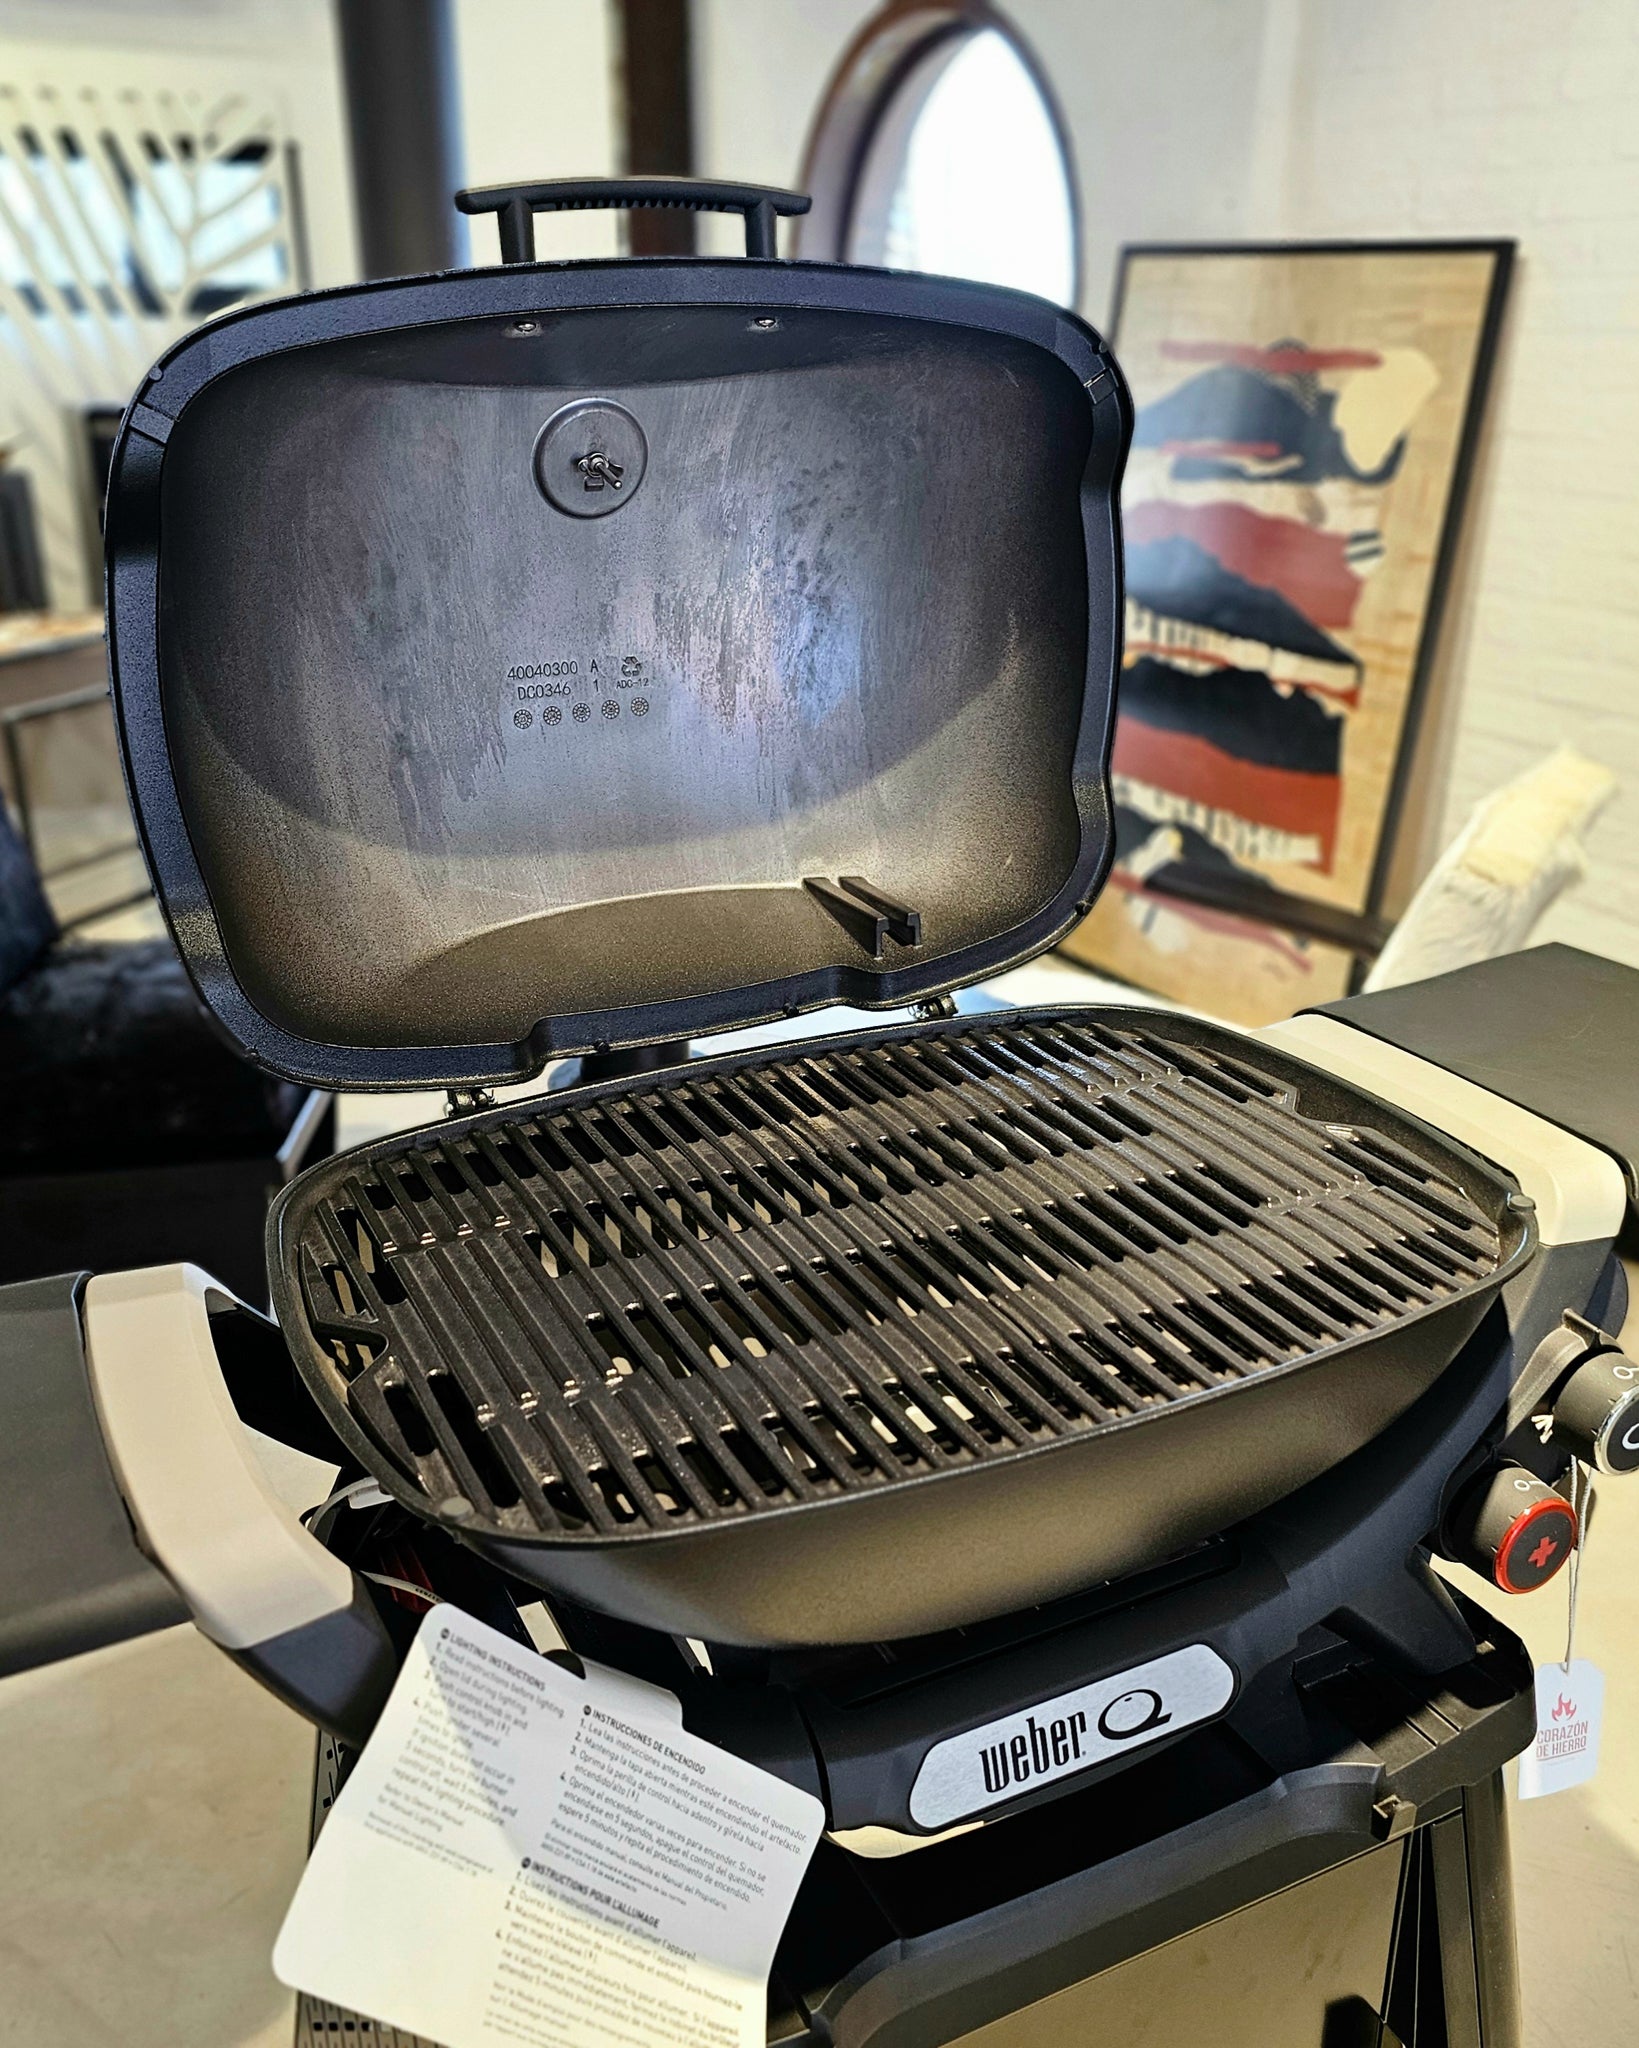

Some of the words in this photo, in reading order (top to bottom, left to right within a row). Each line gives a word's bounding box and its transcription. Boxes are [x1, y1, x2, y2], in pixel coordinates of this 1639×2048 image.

[507, 660, 579, 680] 40040300
[590, 659, 599, 673] A
[517, 682, 572, 700] DC0346
[593, 679, 599, 692] 1
[438, 1660, 459, 1678] Open
[471, 1678, 497, 1699] during
[444, 1647, 465, 1664] Read
[465, 1658, 510, 1688] instructions
[509, 1682, 534, 1701] before
[449, 1633, 488, 1660] LIGHTING
[487, 1654, 546, 1692] INSTRUCTIONS
[454, 1687, 484, 1706] control
[482, 1700, 503, 1716] knob
[502, 1711, 512, 1721] in
[512, 1718, 528, 1729] and
[471, 1728, 501, 1747] several
[591, 1708, 653, 1747] INSTRUCCIONES
[652, 1740, 663, 1753] DE
[663, 1746, 706, 1775] ENCENDIDO
[979, 1711, 1087, 1793] weber
[1098, 1689, 1172, 1740] Q
[1536, 1744, 1549, 1758] DE
[1552, 1736, 1587, 1755] HIERRO
[1537, 1720, 1588, 1744] CORAZÓN
[469, 1758, 483, 1769] not
[483, 1765, 505, 1780] occur
[506, 1775, 515, 1784] in
[480, 1778, 506, 1797] burner
[573, 1765, 625, 1795] encendido/alto
[574, 1731, 582, 1742] 2.
[583, 1736, 618, 1761] Mantenga
[619, 1754, 627, 1765] la
[627, 1758, 643, 1773] tapa
[643, 1769, 668, 1786] abierta
[667, 1781, 698, 1802] mientras
[714, 1806, 760, 1833] encendiendo
[759, 1829, 769, 1837] el
[578, 1717, 587, 1729] 1.
[587, 1722, 602, 1737] Lea
[602, 1730, 614, 1743] las
[615, 1737, 660, 1767] instrucciones
[661, 1763, 680, 1777] antes
[679, 1770, 690, 1782] de
[689, 1778, 721, 1798] proceder
[727, 1797, 761, 1818] encender
[761, 1814, 770, 1823] el
[501, 1805, 517, 1816] and
[569, 1744, 578, 1756] 3.
[578, 1749, 605, 1770] Oprima
[605, 1763, 613, 1774] la
[613, 1770, 636, 1786] perilla
[637, 1780, 646, 1791] de
[646, 1787, 671, 1803] control
[670, 1797, 690, 1813] hacia
[690, 1809, 717, 1827] adentro
[716, 1823, 722, 1831] y
[743, 1835, 764, 1851] hacia
[557, 1802, 583, 1820] espere
[583, 1812, 590, 1823] 5
[589, 1817, 619, 1837] minutos
[618, 1832, 624, 1841] y
[624, 1835, 645, 1850] repita
[645, 1845, 654, 1854] el
[652, 1849, 703, 1879] procedimiento
[703, 1872, 713, 1883] de
[563, 1790, 603, 1815] encendiese
[604, 1811, 614, 1820] en
[614, 1814, 620, 1823] 5
[655, 1837, 681, 1853] apague
[681, 1849, 690, 1857] el
[689, 1853, 715, 1870] control
[715, 1865, 727, 1876] del
[568, 1775, 595, 1796] Oprima
[596, 1790, 604, 1800] el
[604, 1795, 645, 1821] encendedor
[644, 1816, 665, 1831] varias
[666, 1827, 686, 1841] veces
[685, 1837, 703, 1850] para
[738, 1861, 747, 1871] Si
[746, 1867, 756, 1877] no
[756, 1873, 766, 1881] se
[531, 1860, 588, 1895] INSTRUCTIONS
[588, 1887, 611, 1906] POUR
[612, 1898, 659, 1928] L'ALLUMAGE
[660, 1872, 683, 1889] Manual
[558, 1891, 602, 1919] instructions
[603, 1914, 625, 1929] avant
